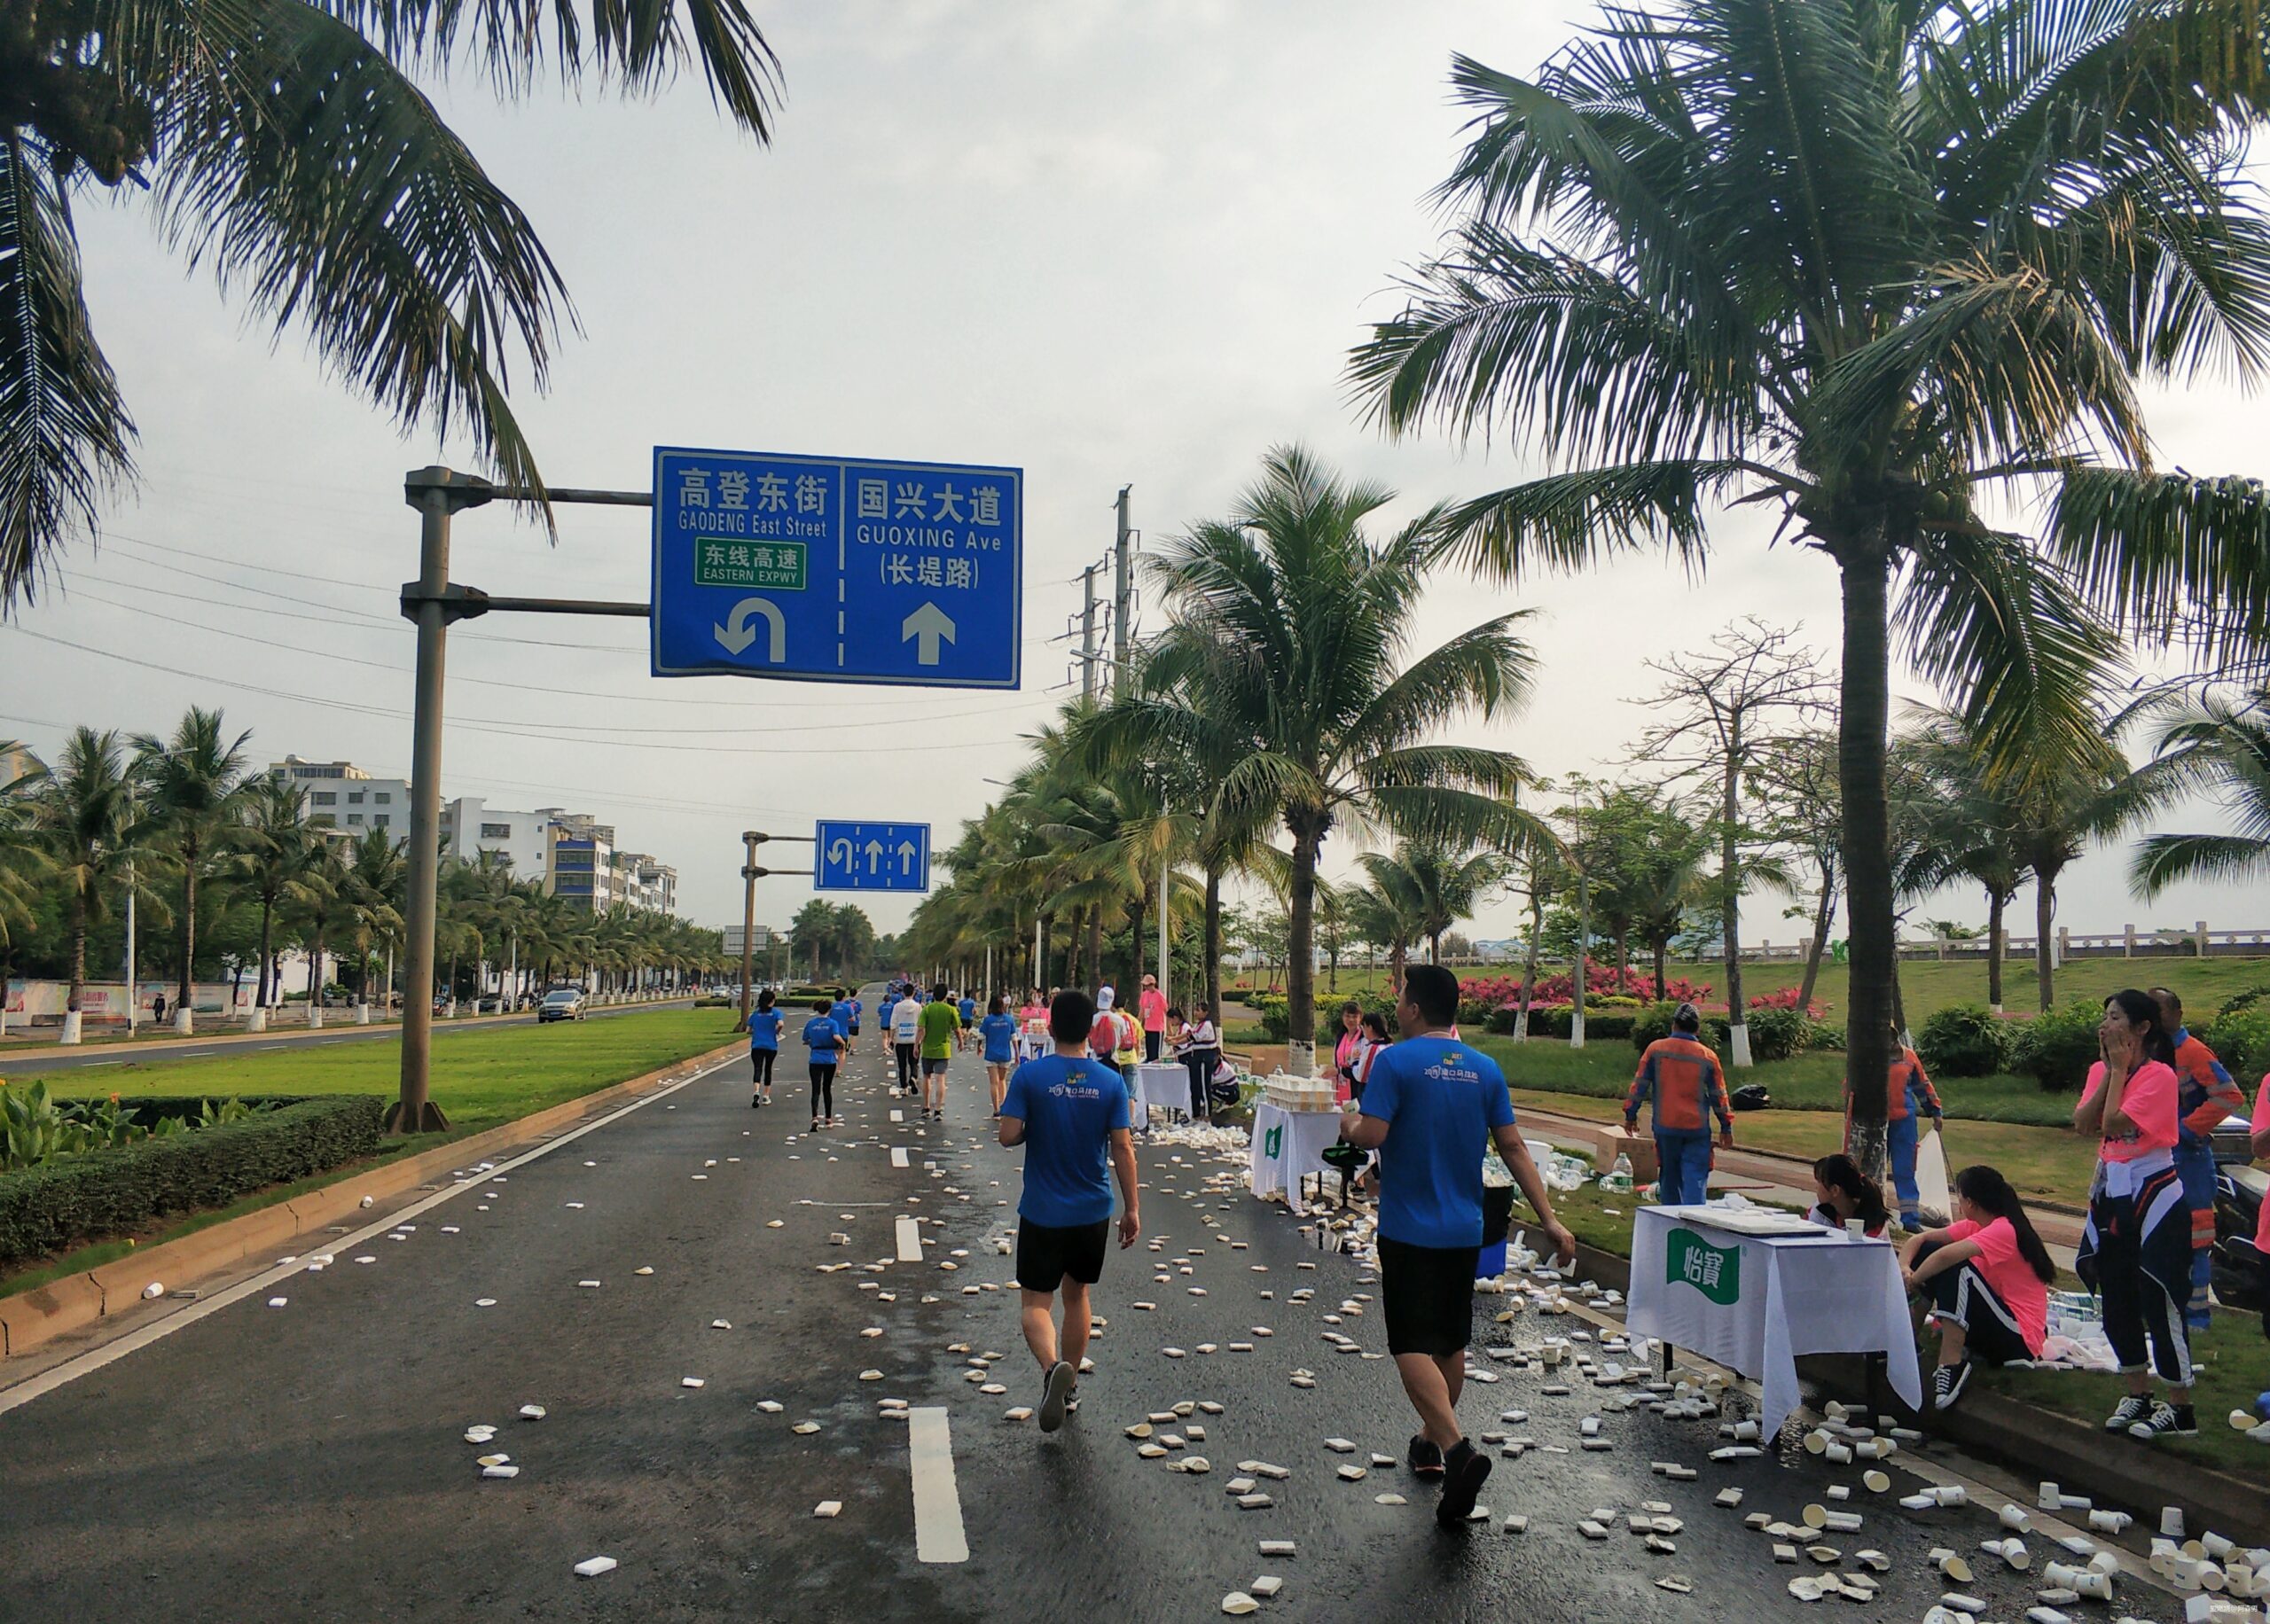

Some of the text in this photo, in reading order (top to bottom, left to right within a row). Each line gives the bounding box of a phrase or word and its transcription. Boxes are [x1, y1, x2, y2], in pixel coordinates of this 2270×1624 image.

[678, 467, 827, 516] 高登东街
[857, 479, 1001, 526] 国兴大道
[678, 510, 827, 537] GAODENG East Street
[857, 524, 1001, 550] GUOXING Ave
[704, 543, 798, 570] 东线高速
[881, 552, 978, 589] (长堤路)
[703, 567, 797, 584] EASTERN EXPWY
[1684, 1245, 1724, 1289] 怡寶
